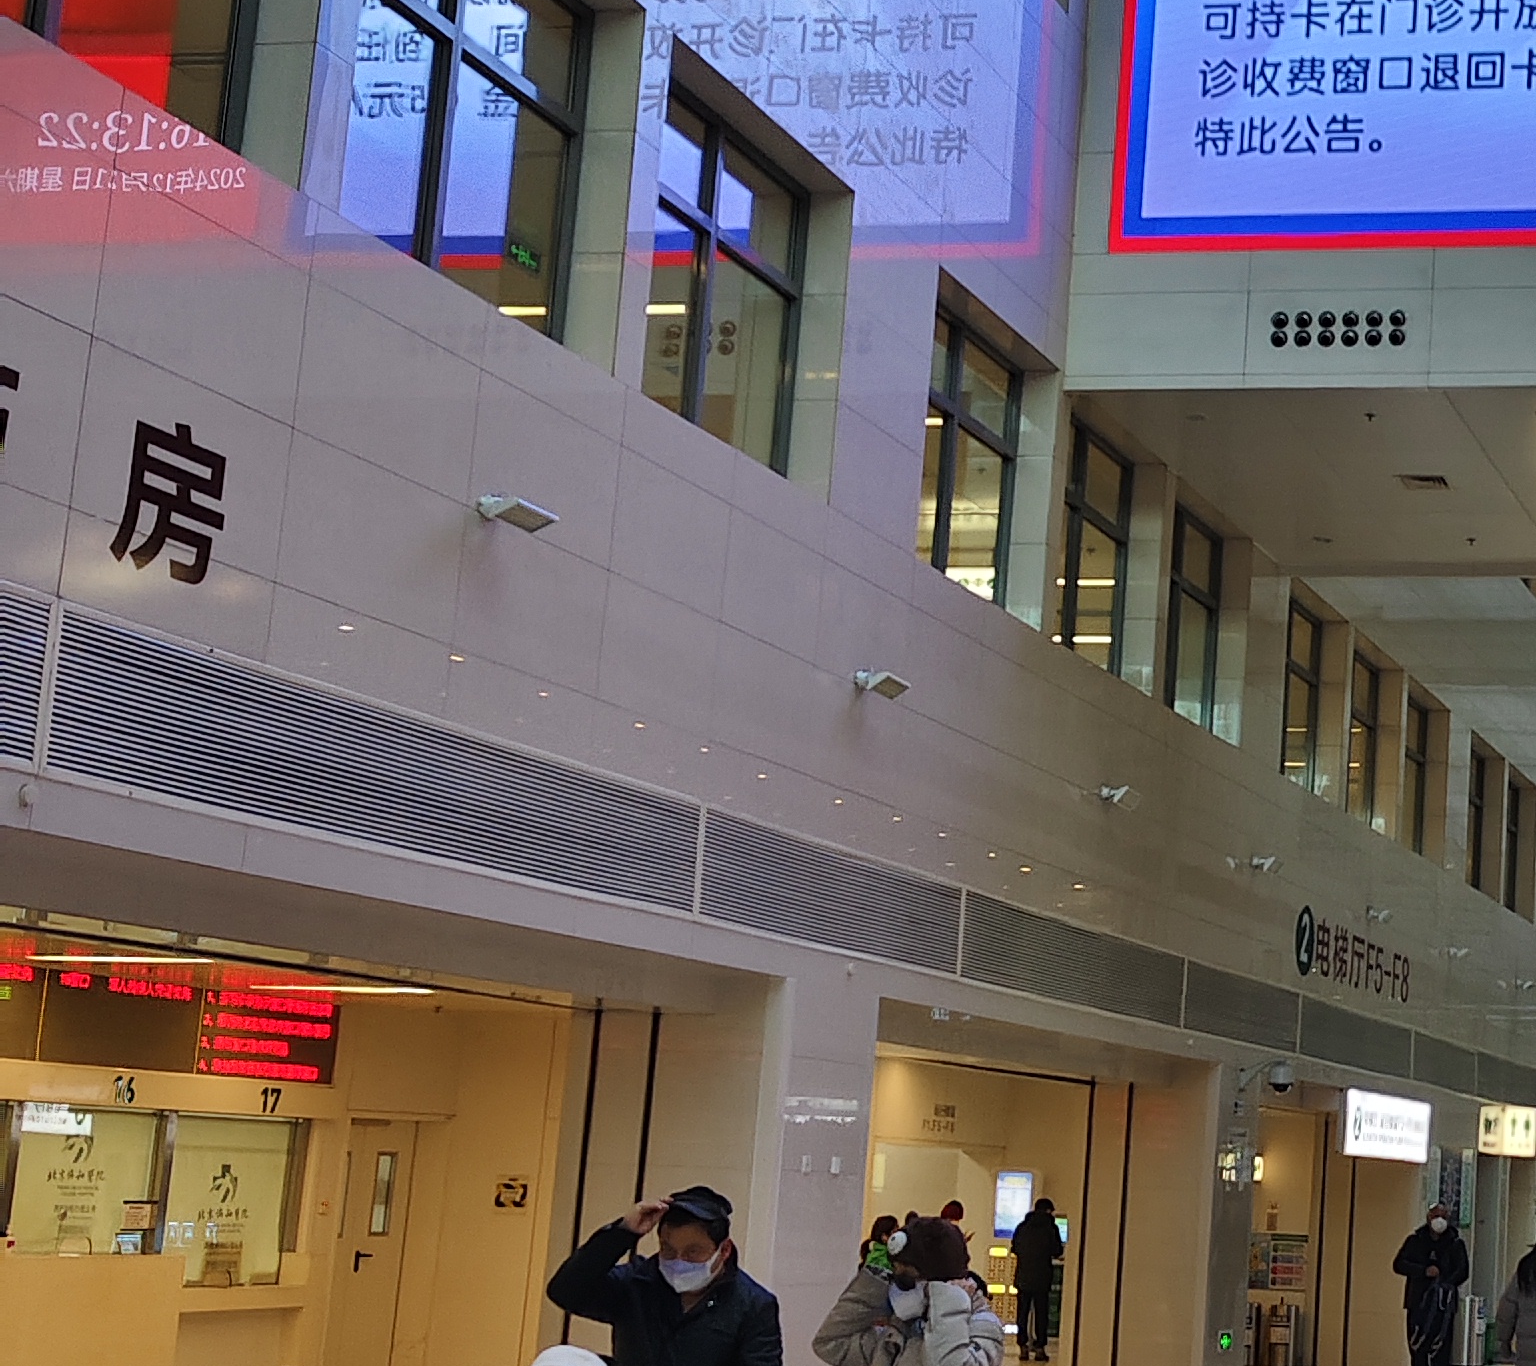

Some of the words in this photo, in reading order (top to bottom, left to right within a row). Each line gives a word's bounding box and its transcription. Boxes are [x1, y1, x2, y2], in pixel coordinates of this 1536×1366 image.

[1194, 115, 1384, 157] 特此公告。
[1315, 918, 1411, 1003] 电梯厅F5-F8
[113, 1074, 136, 1105] 16
[260, 1088, 282, 1114] 17
